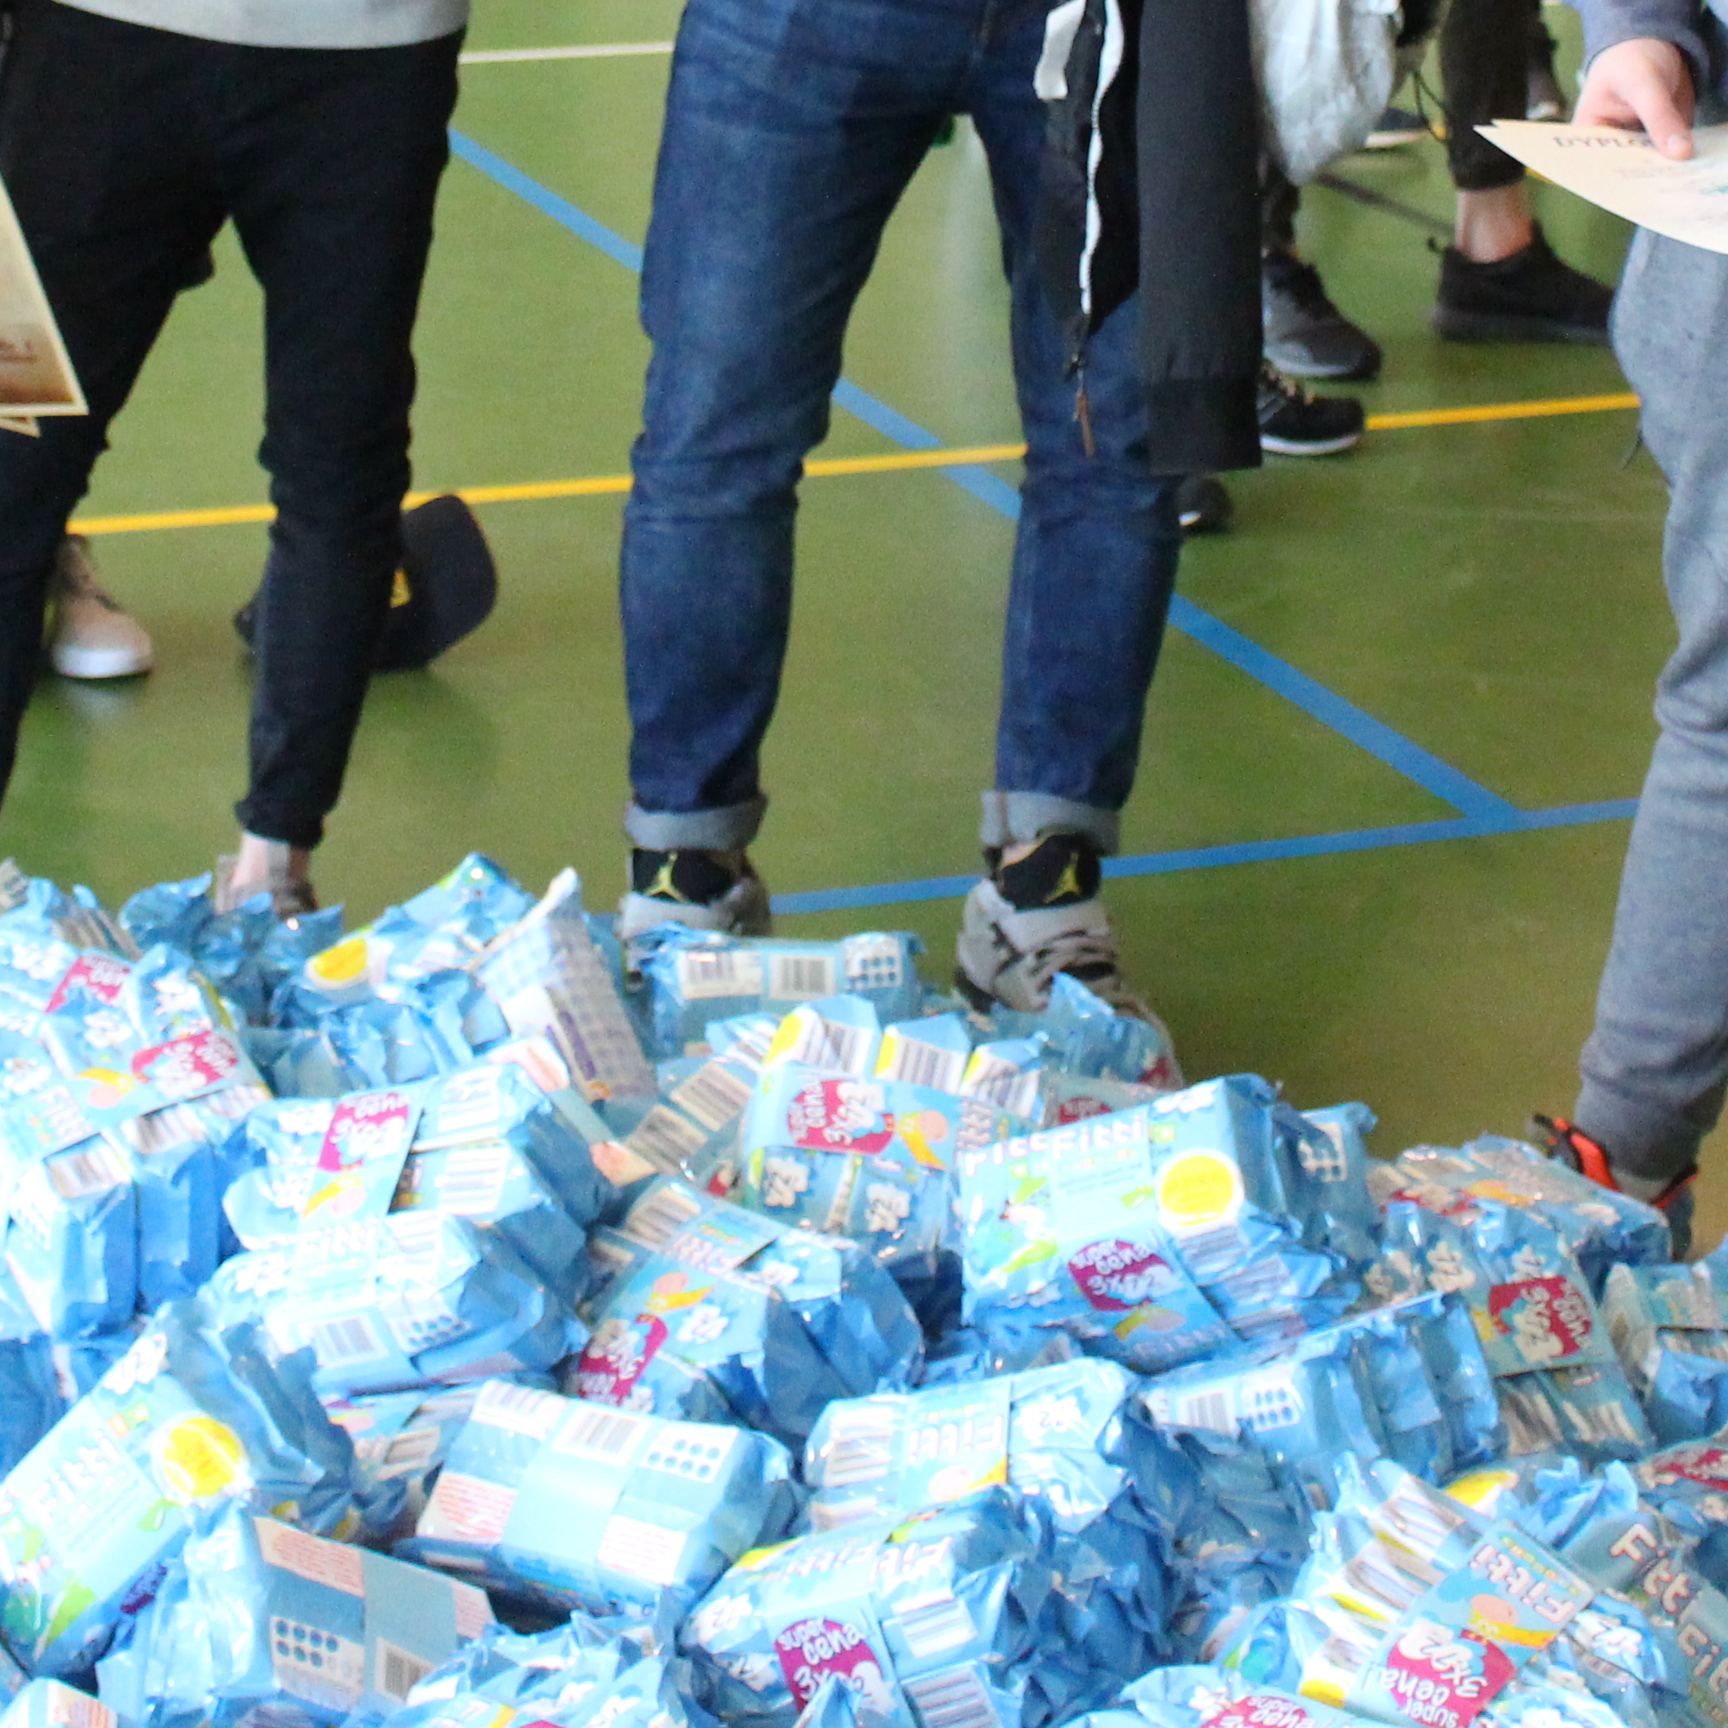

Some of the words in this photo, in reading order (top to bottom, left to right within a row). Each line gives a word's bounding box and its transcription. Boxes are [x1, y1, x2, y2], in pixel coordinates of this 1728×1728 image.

[1052, 1114, 1144, 1161] Fitti
[297, 1221, 378, 1267] Fitti
[908, 1413, 1004, 1465] Fitti
[27, 1431, 120, 1527] Fitti
[1468, 1542, 1577, 1624] Fitti
[777, 1616, 827, 1651] super
[1419, 1632, 1489, 1699] 3x72
[1400, 1697, 1460, 1728] super
